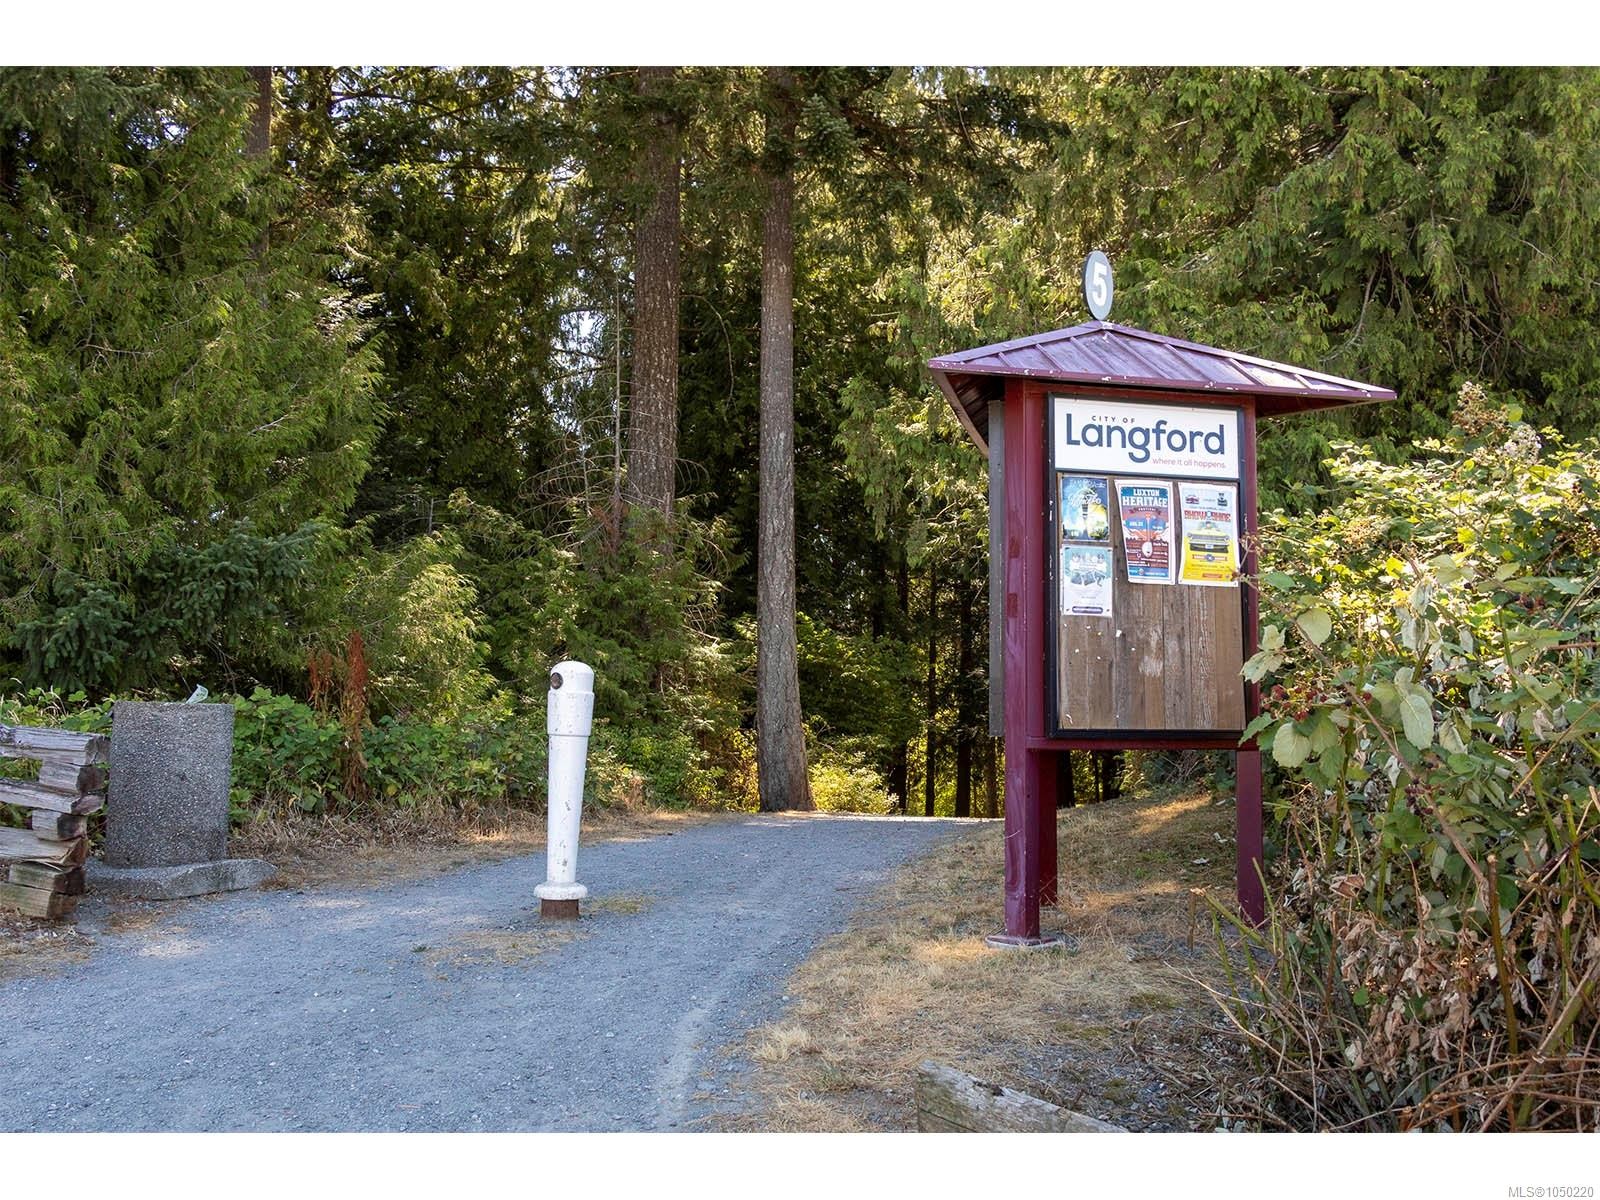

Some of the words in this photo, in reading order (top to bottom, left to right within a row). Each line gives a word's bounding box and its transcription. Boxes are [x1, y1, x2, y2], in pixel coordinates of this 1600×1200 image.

[1092, 261, 1107, 306] 5
[1066, 413, 1225, 463] Langford
[1152, 457, 1176, 466] where
[1183, 459, 1193, 467] all
[1133, 488, 1160, 497] LUXTON
[1122, 496, 1168, 508] HERITAGE
